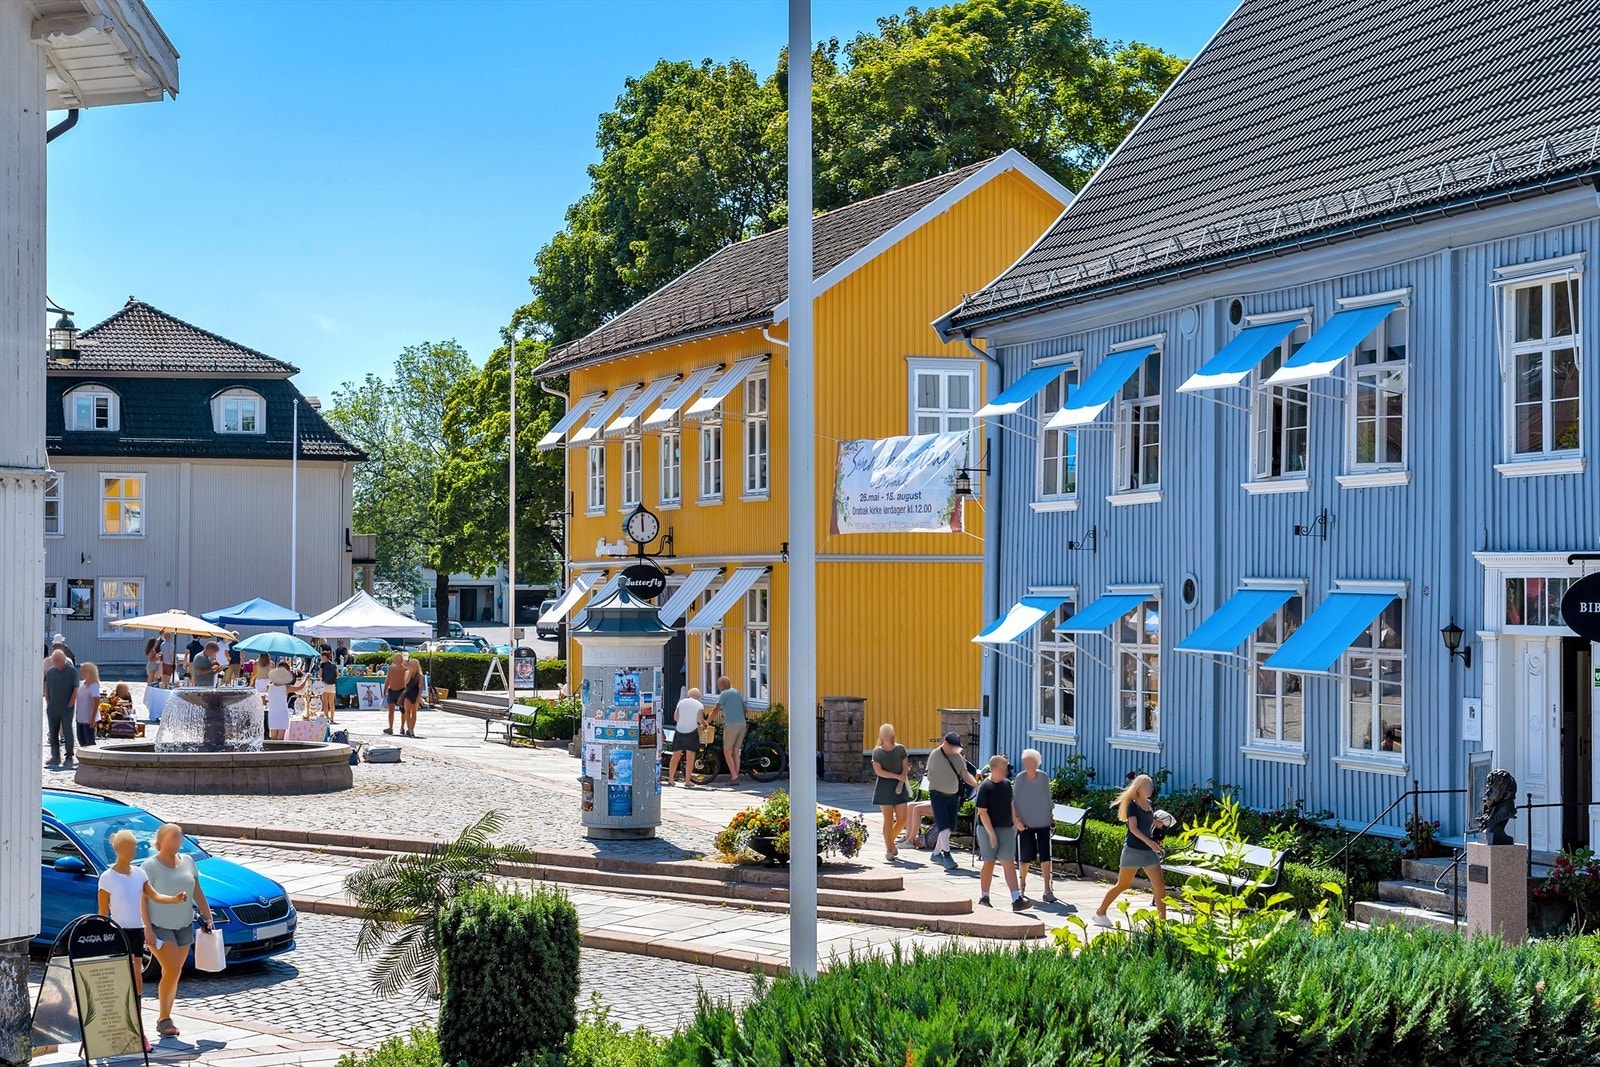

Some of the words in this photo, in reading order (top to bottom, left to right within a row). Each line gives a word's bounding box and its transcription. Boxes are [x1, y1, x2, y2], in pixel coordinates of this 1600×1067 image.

[860, 493, 880, 502] 26.mai
[896, 492, 922, 502] august
[870, 506, 882, 514] kirke
